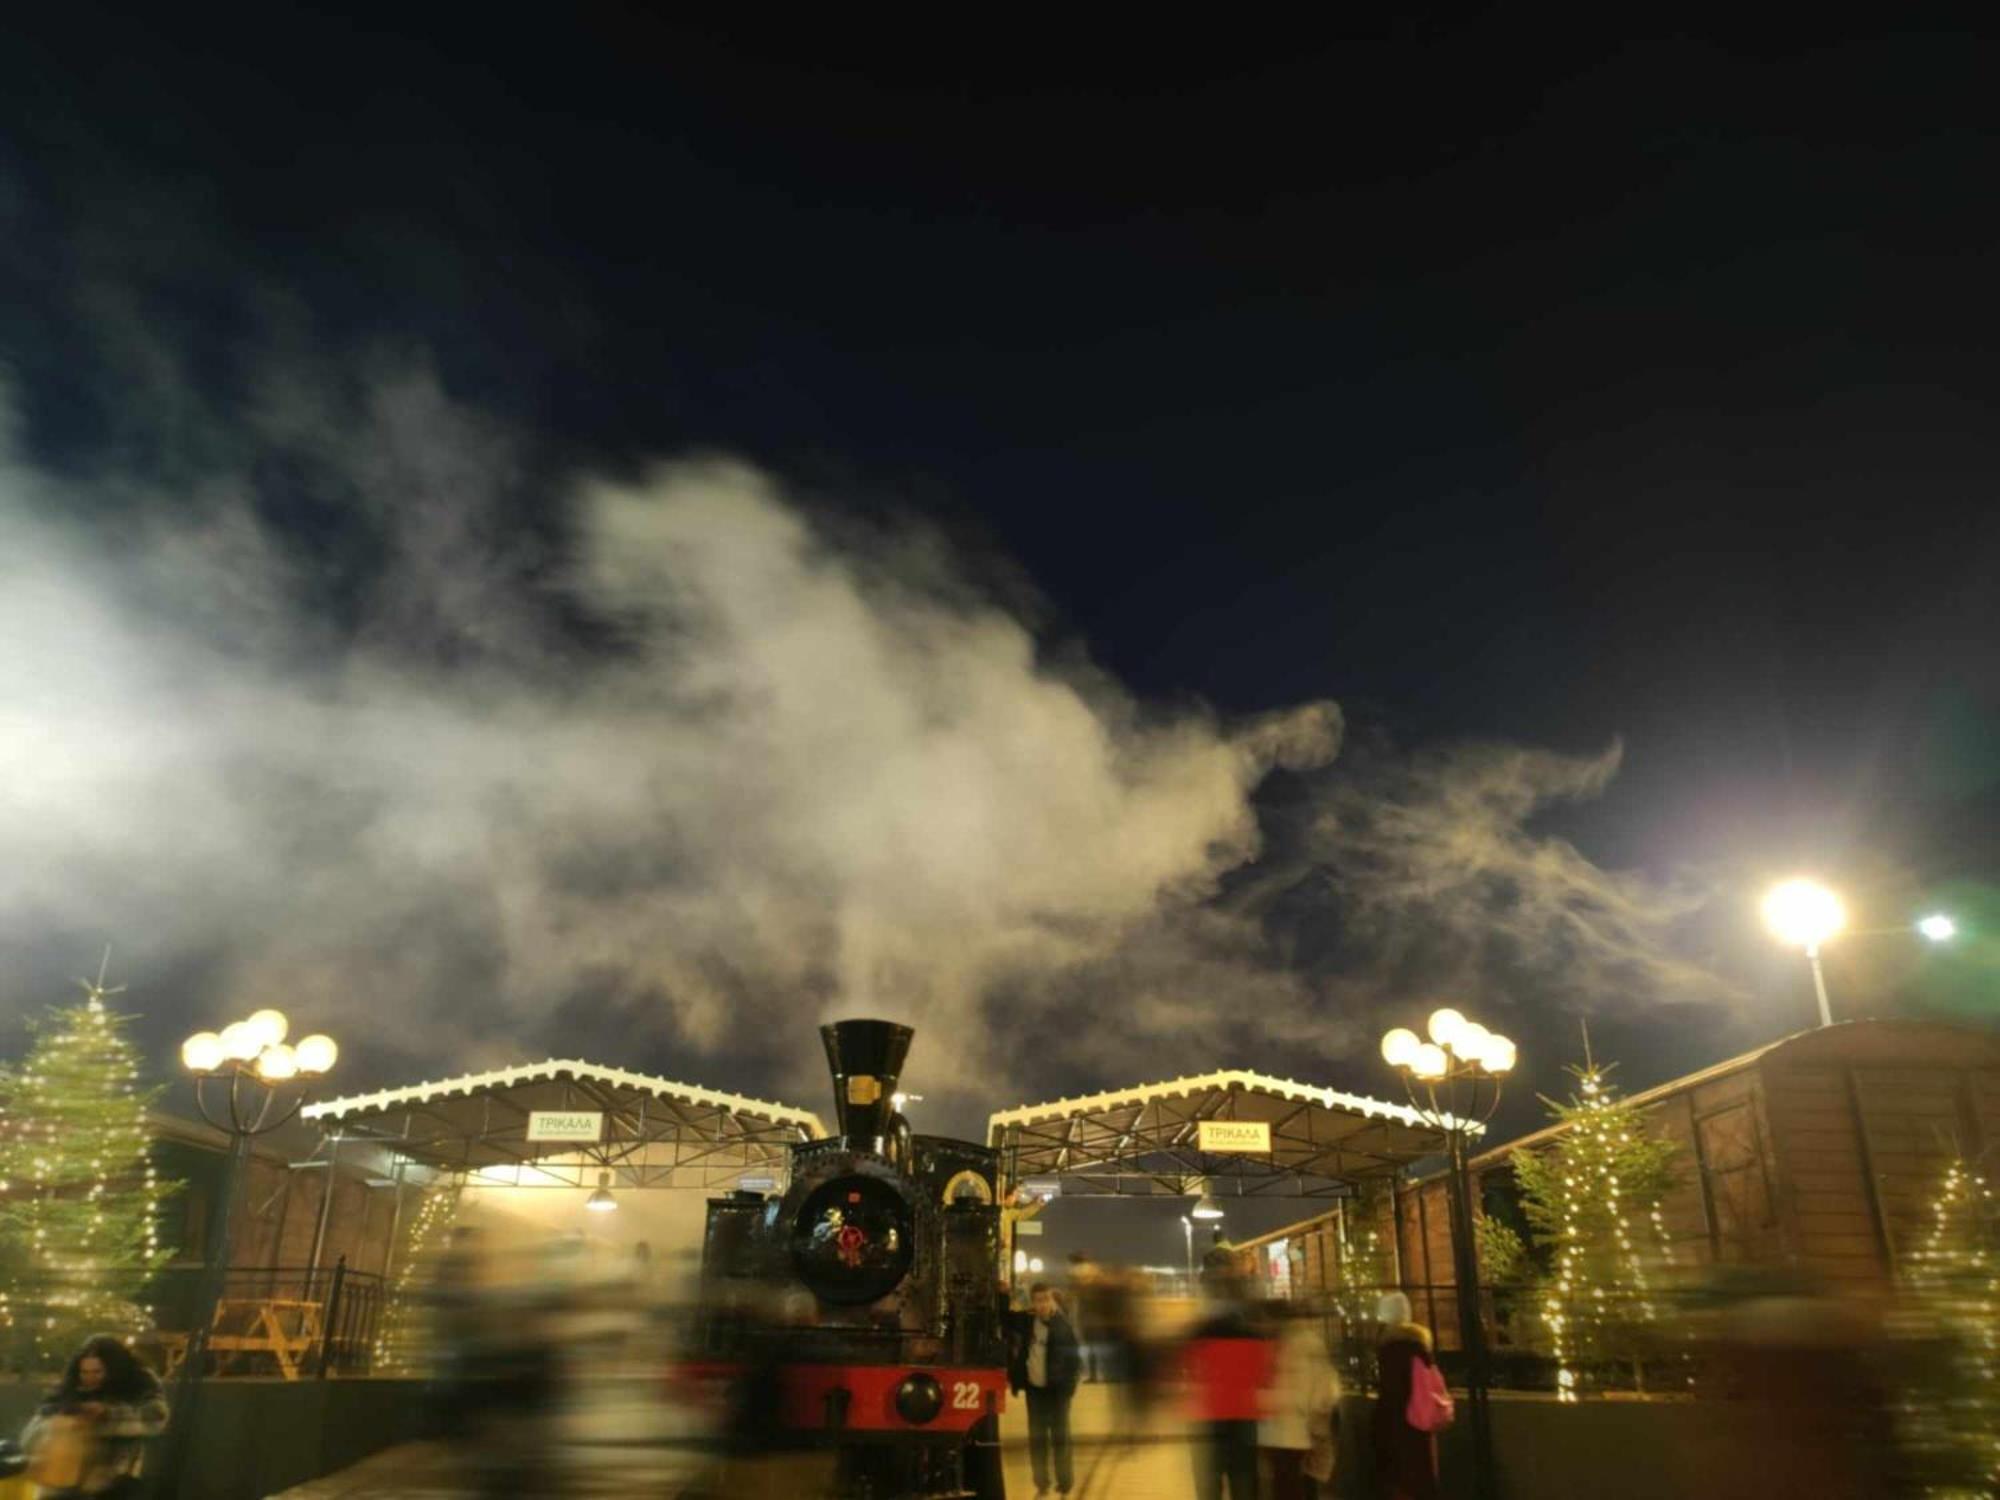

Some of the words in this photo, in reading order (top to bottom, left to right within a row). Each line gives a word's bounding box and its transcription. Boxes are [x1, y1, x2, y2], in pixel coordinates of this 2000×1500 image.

[538, 1117, 593, 1129] ΤΡΙΚΑΛΑ
[1207, 1127, 1262, 1140] ΤΡΙΚΑΛΑ
[953, 1382, 980, 1409] 22
